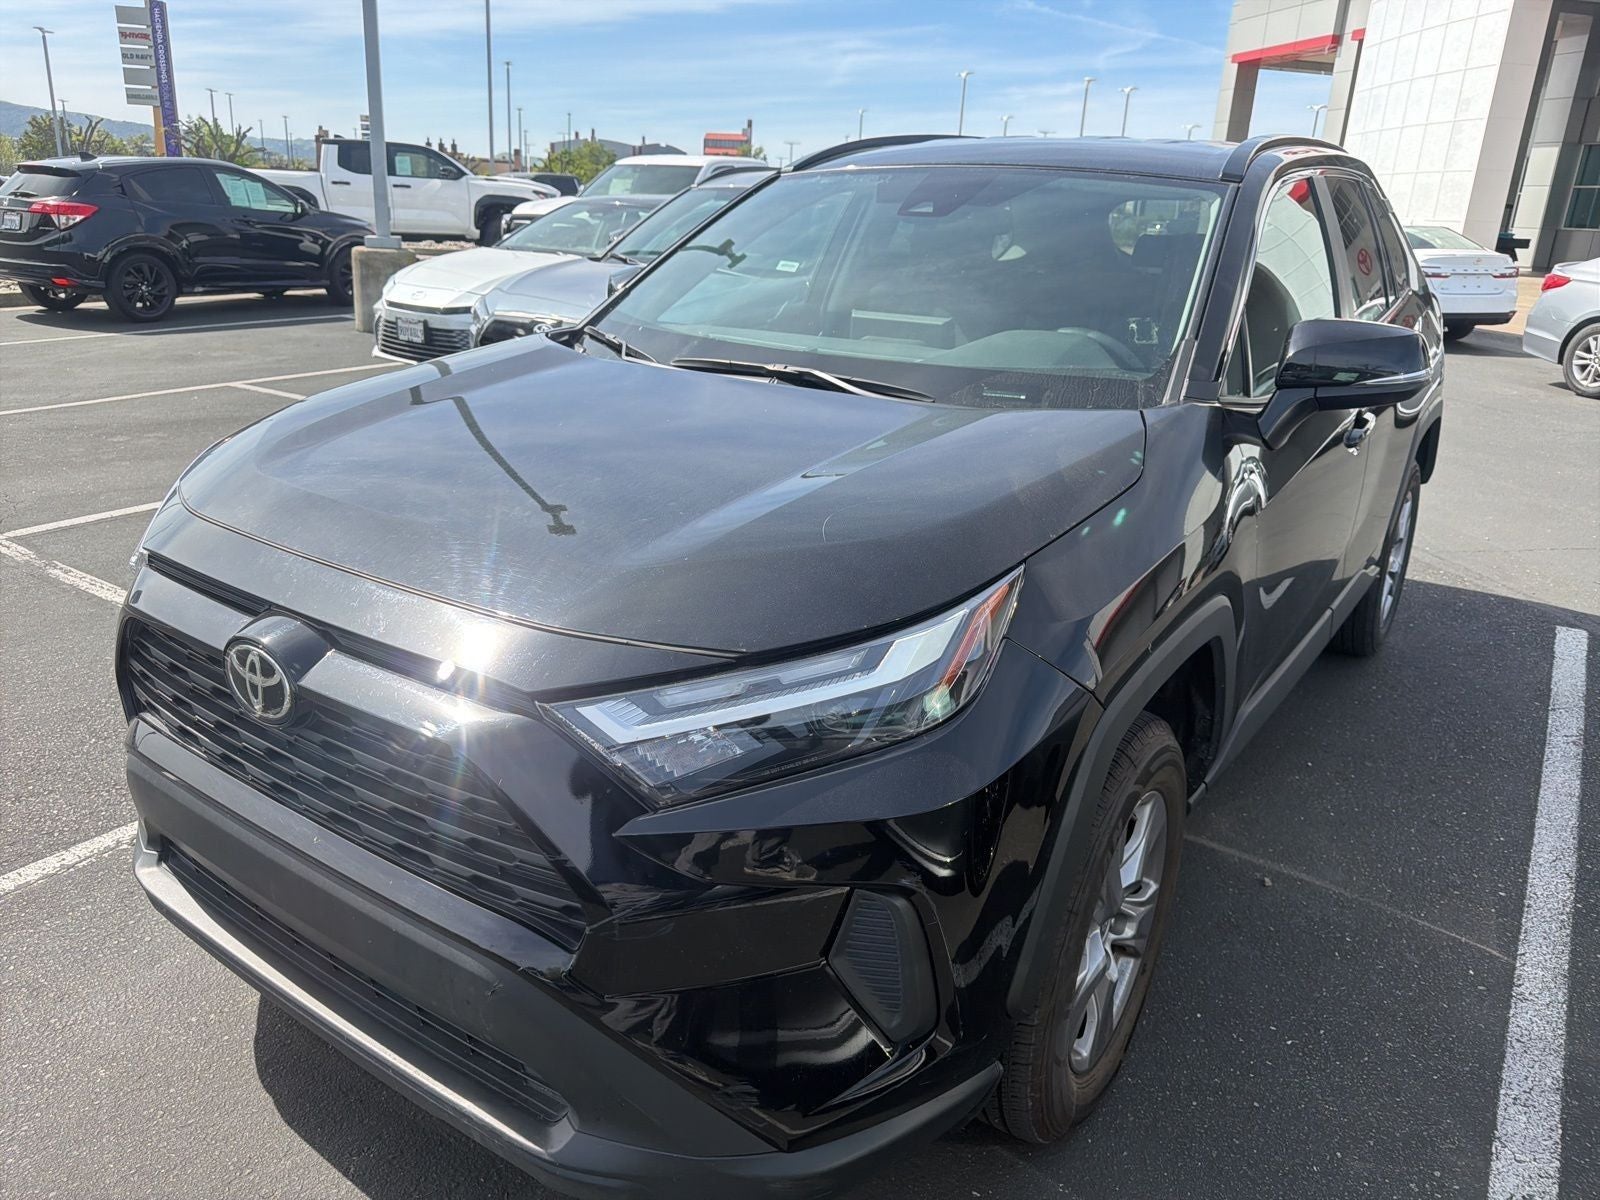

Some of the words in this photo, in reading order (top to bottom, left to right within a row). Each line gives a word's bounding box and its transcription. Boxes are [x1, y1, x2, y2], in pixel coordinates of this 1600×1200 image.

[122, 52, 135, 60] OLD
[153, 8, 163, 44] HACIENDA
[158, 44, 168, 83] CROSSINGS
